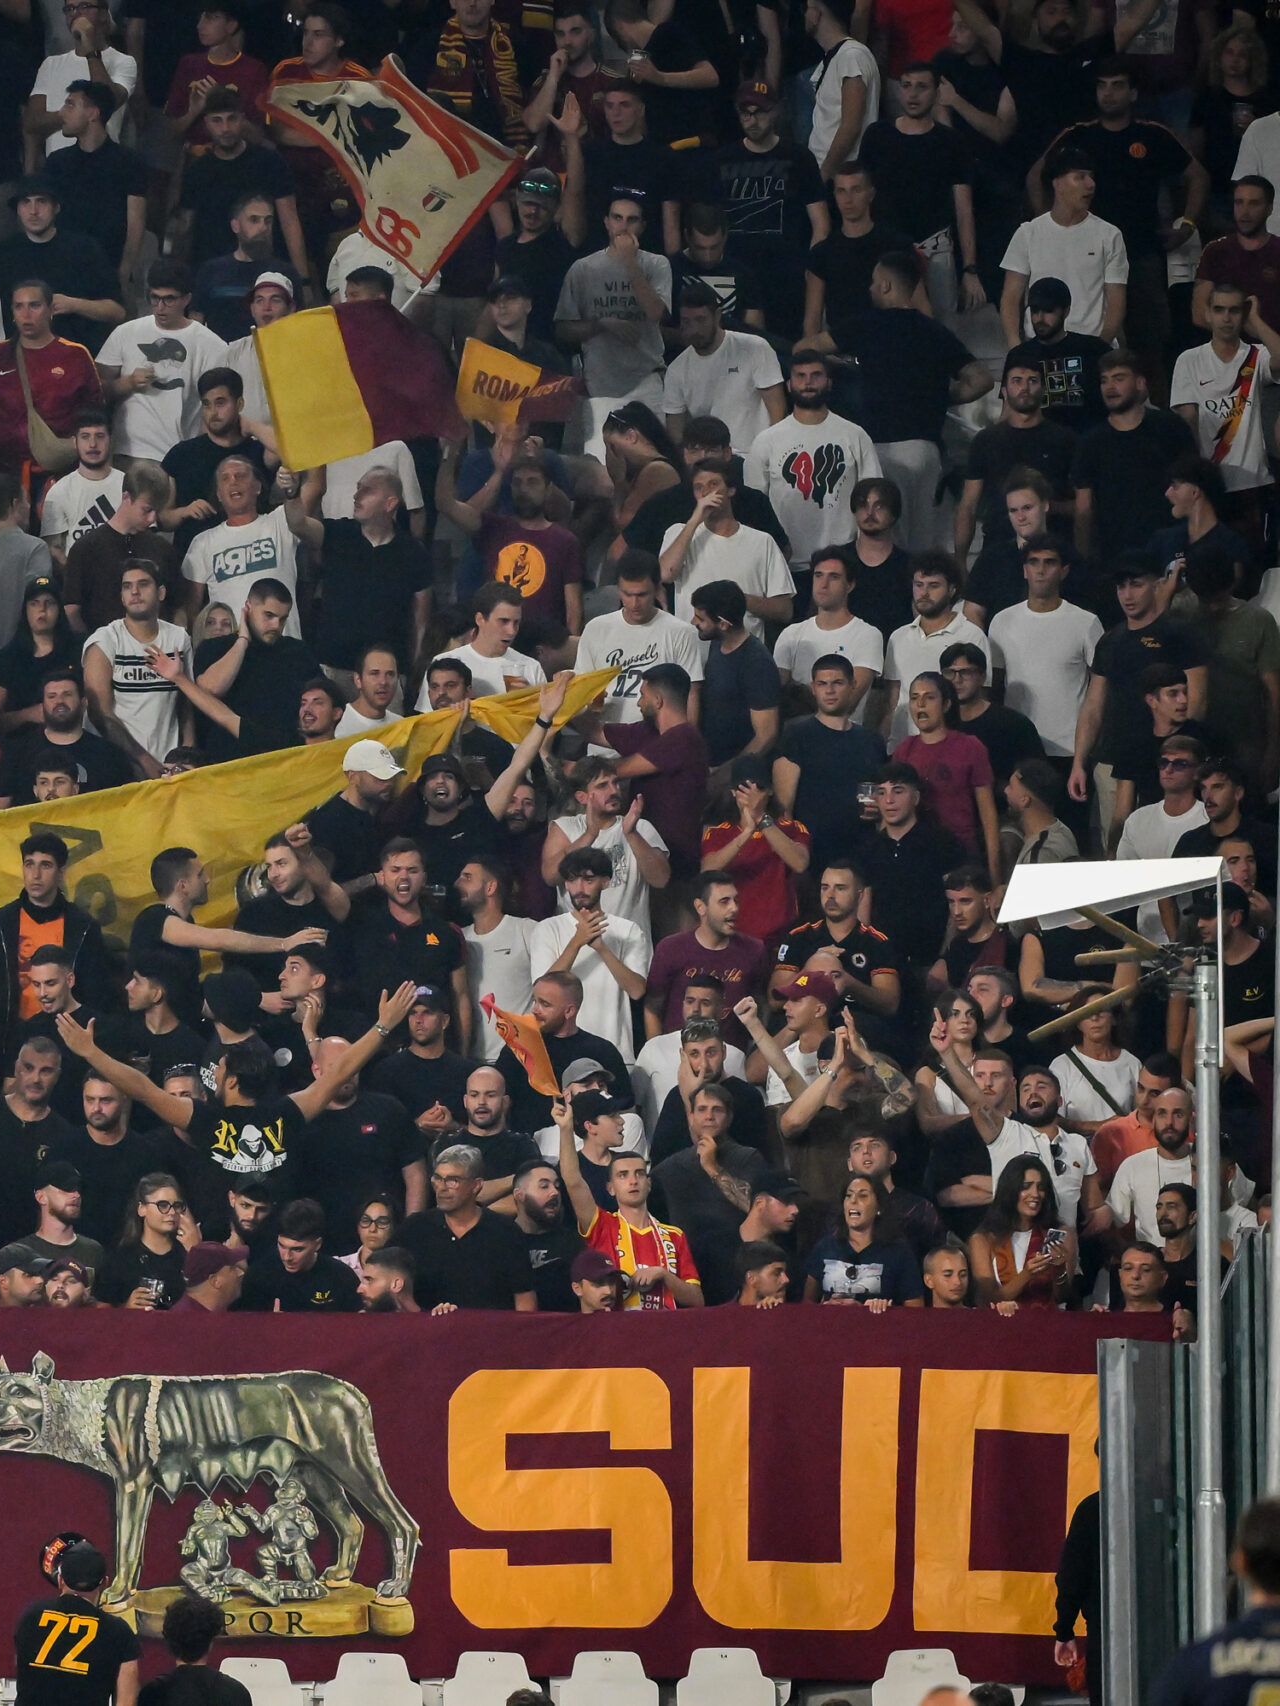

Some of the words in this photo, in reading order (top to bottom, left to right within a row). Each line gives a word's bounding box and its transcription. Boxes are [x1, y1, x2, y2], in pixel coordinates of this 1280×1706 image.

[753, 81, 768, 95] 10
[604, 280, 618, 292] VI
[621, 280, 631, 291] H
[605, 642, 659, 669] Russell
[449, 1367, 1100, 1636] SUD
[223, 1612, 313, 1636] PQR
[35, 1612, 99, 1671] 72
